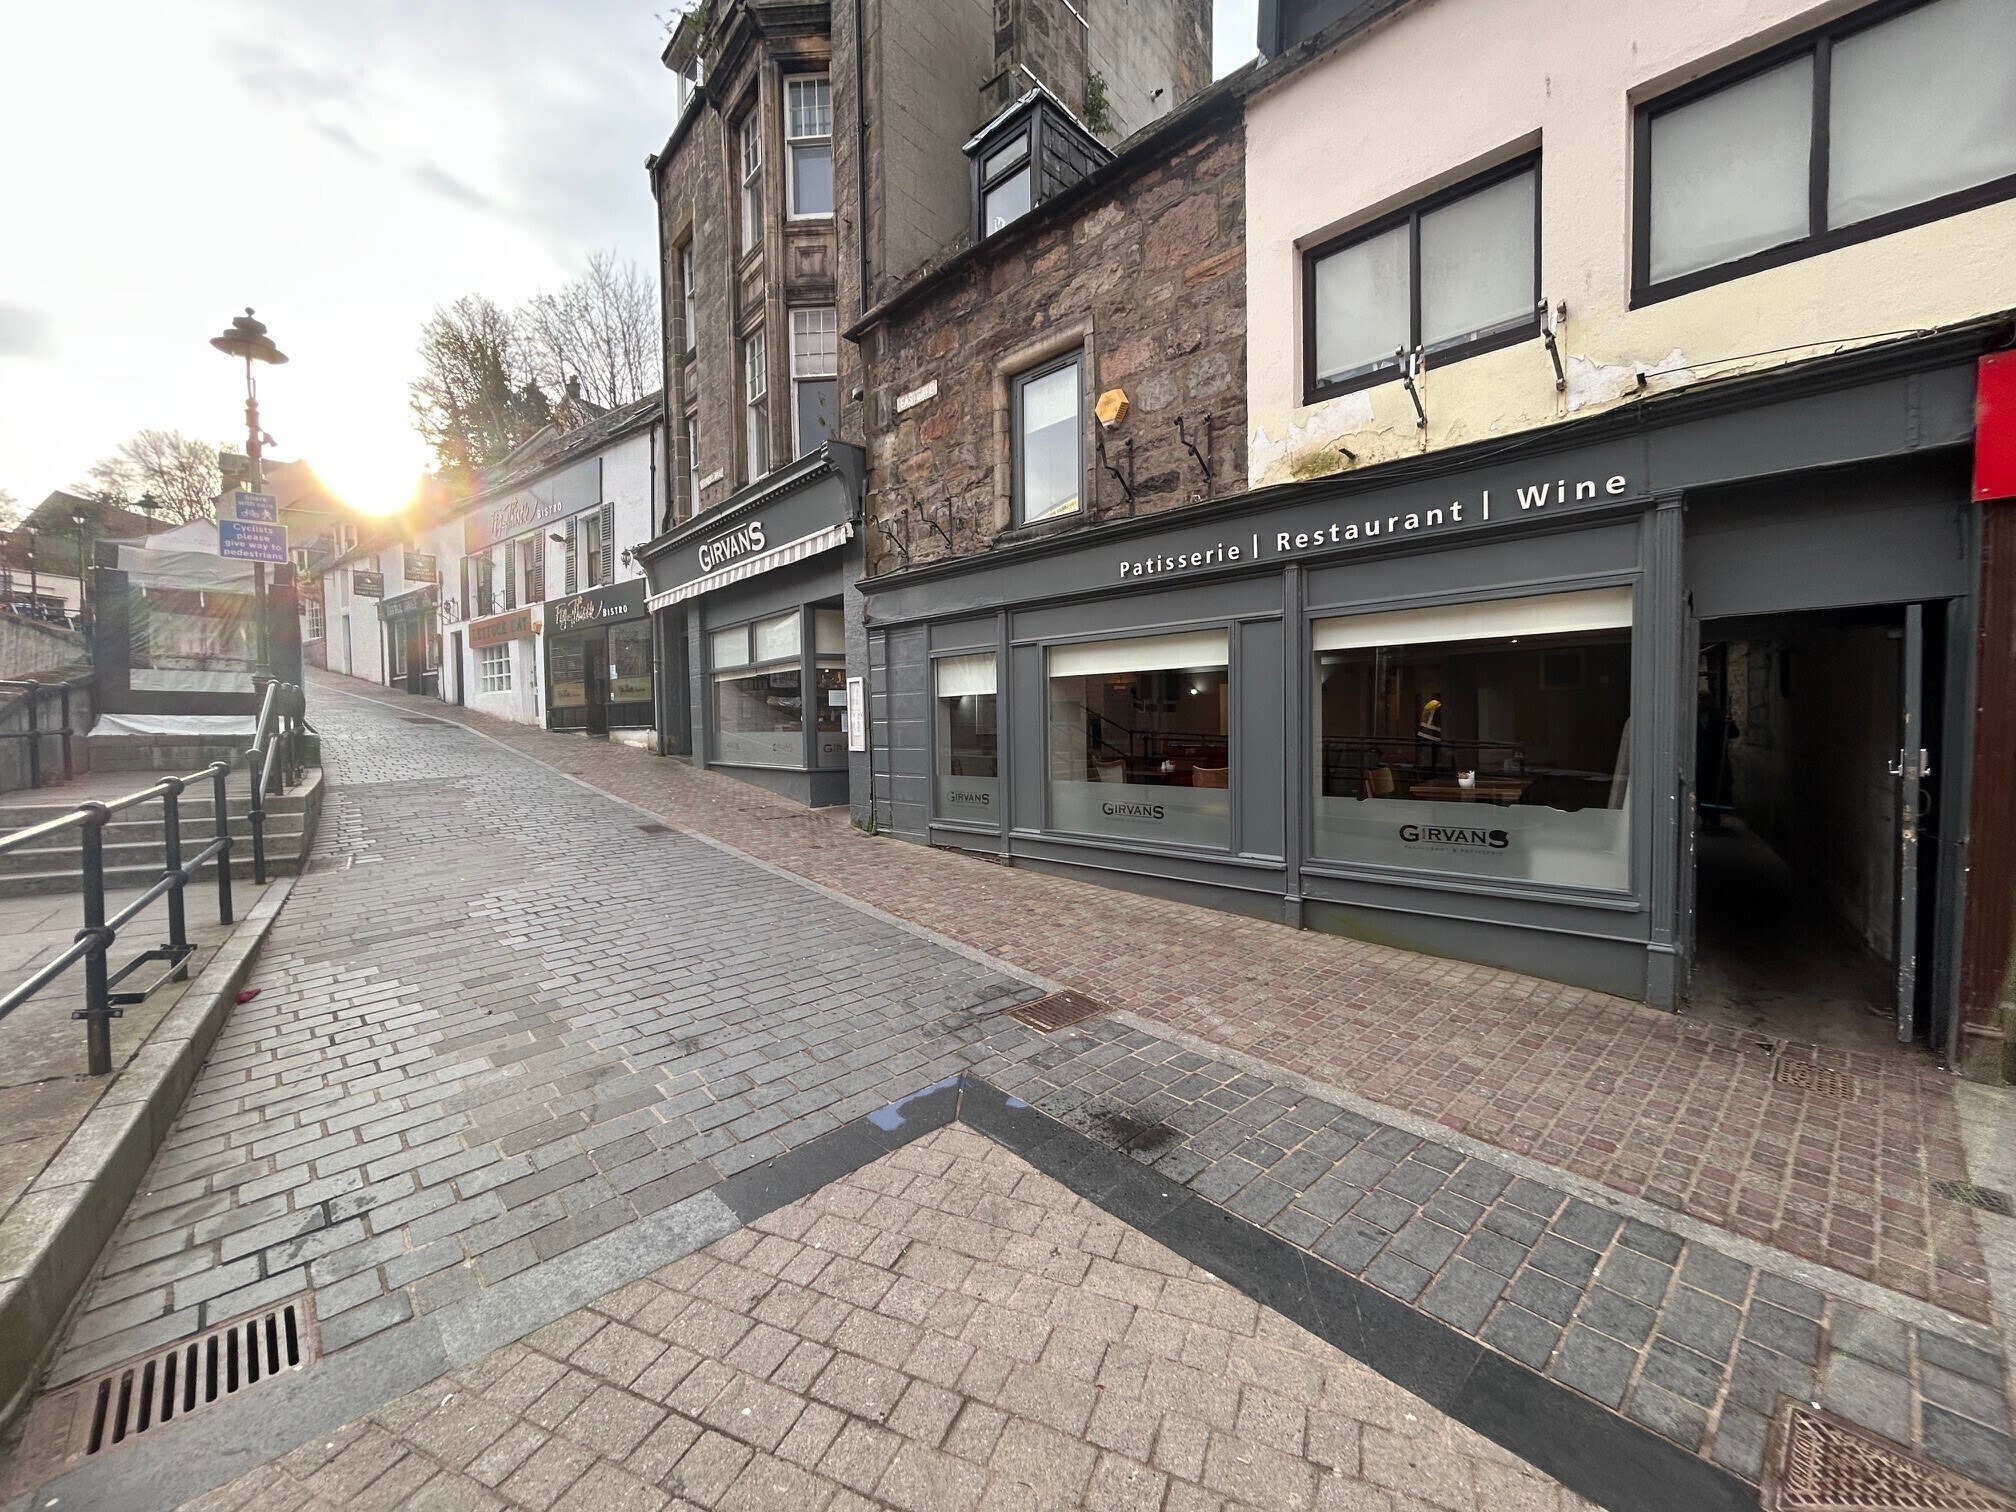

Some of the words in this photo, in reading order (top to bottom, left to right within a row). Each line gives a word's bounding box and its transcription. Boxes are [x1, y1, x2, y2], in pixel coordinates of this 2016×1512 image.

[537, 502, 562, 519] BISTRO
[233, 523, 273, 534] Cyclists
[1119, 542, 1240, 578] Patisserie
[1277, 501, 1463, 551] Restaurant
[1516, 474, 1627, 510] Wine
[236, 533, 270, 542] please
[248, 542, 268, 550] way
[271, 543, 282, 551] to
[698, 521, 765, 571] GIRVANS
[223, 548, 284, 560] pedestrians
[602, 604, 628, 618] BISTRO
[946, 791, 990, 805] GIRVANS
[1102, 802, 1165, 820] GIRVANS
[1399, 824, 1509, 849] GIRVANS
